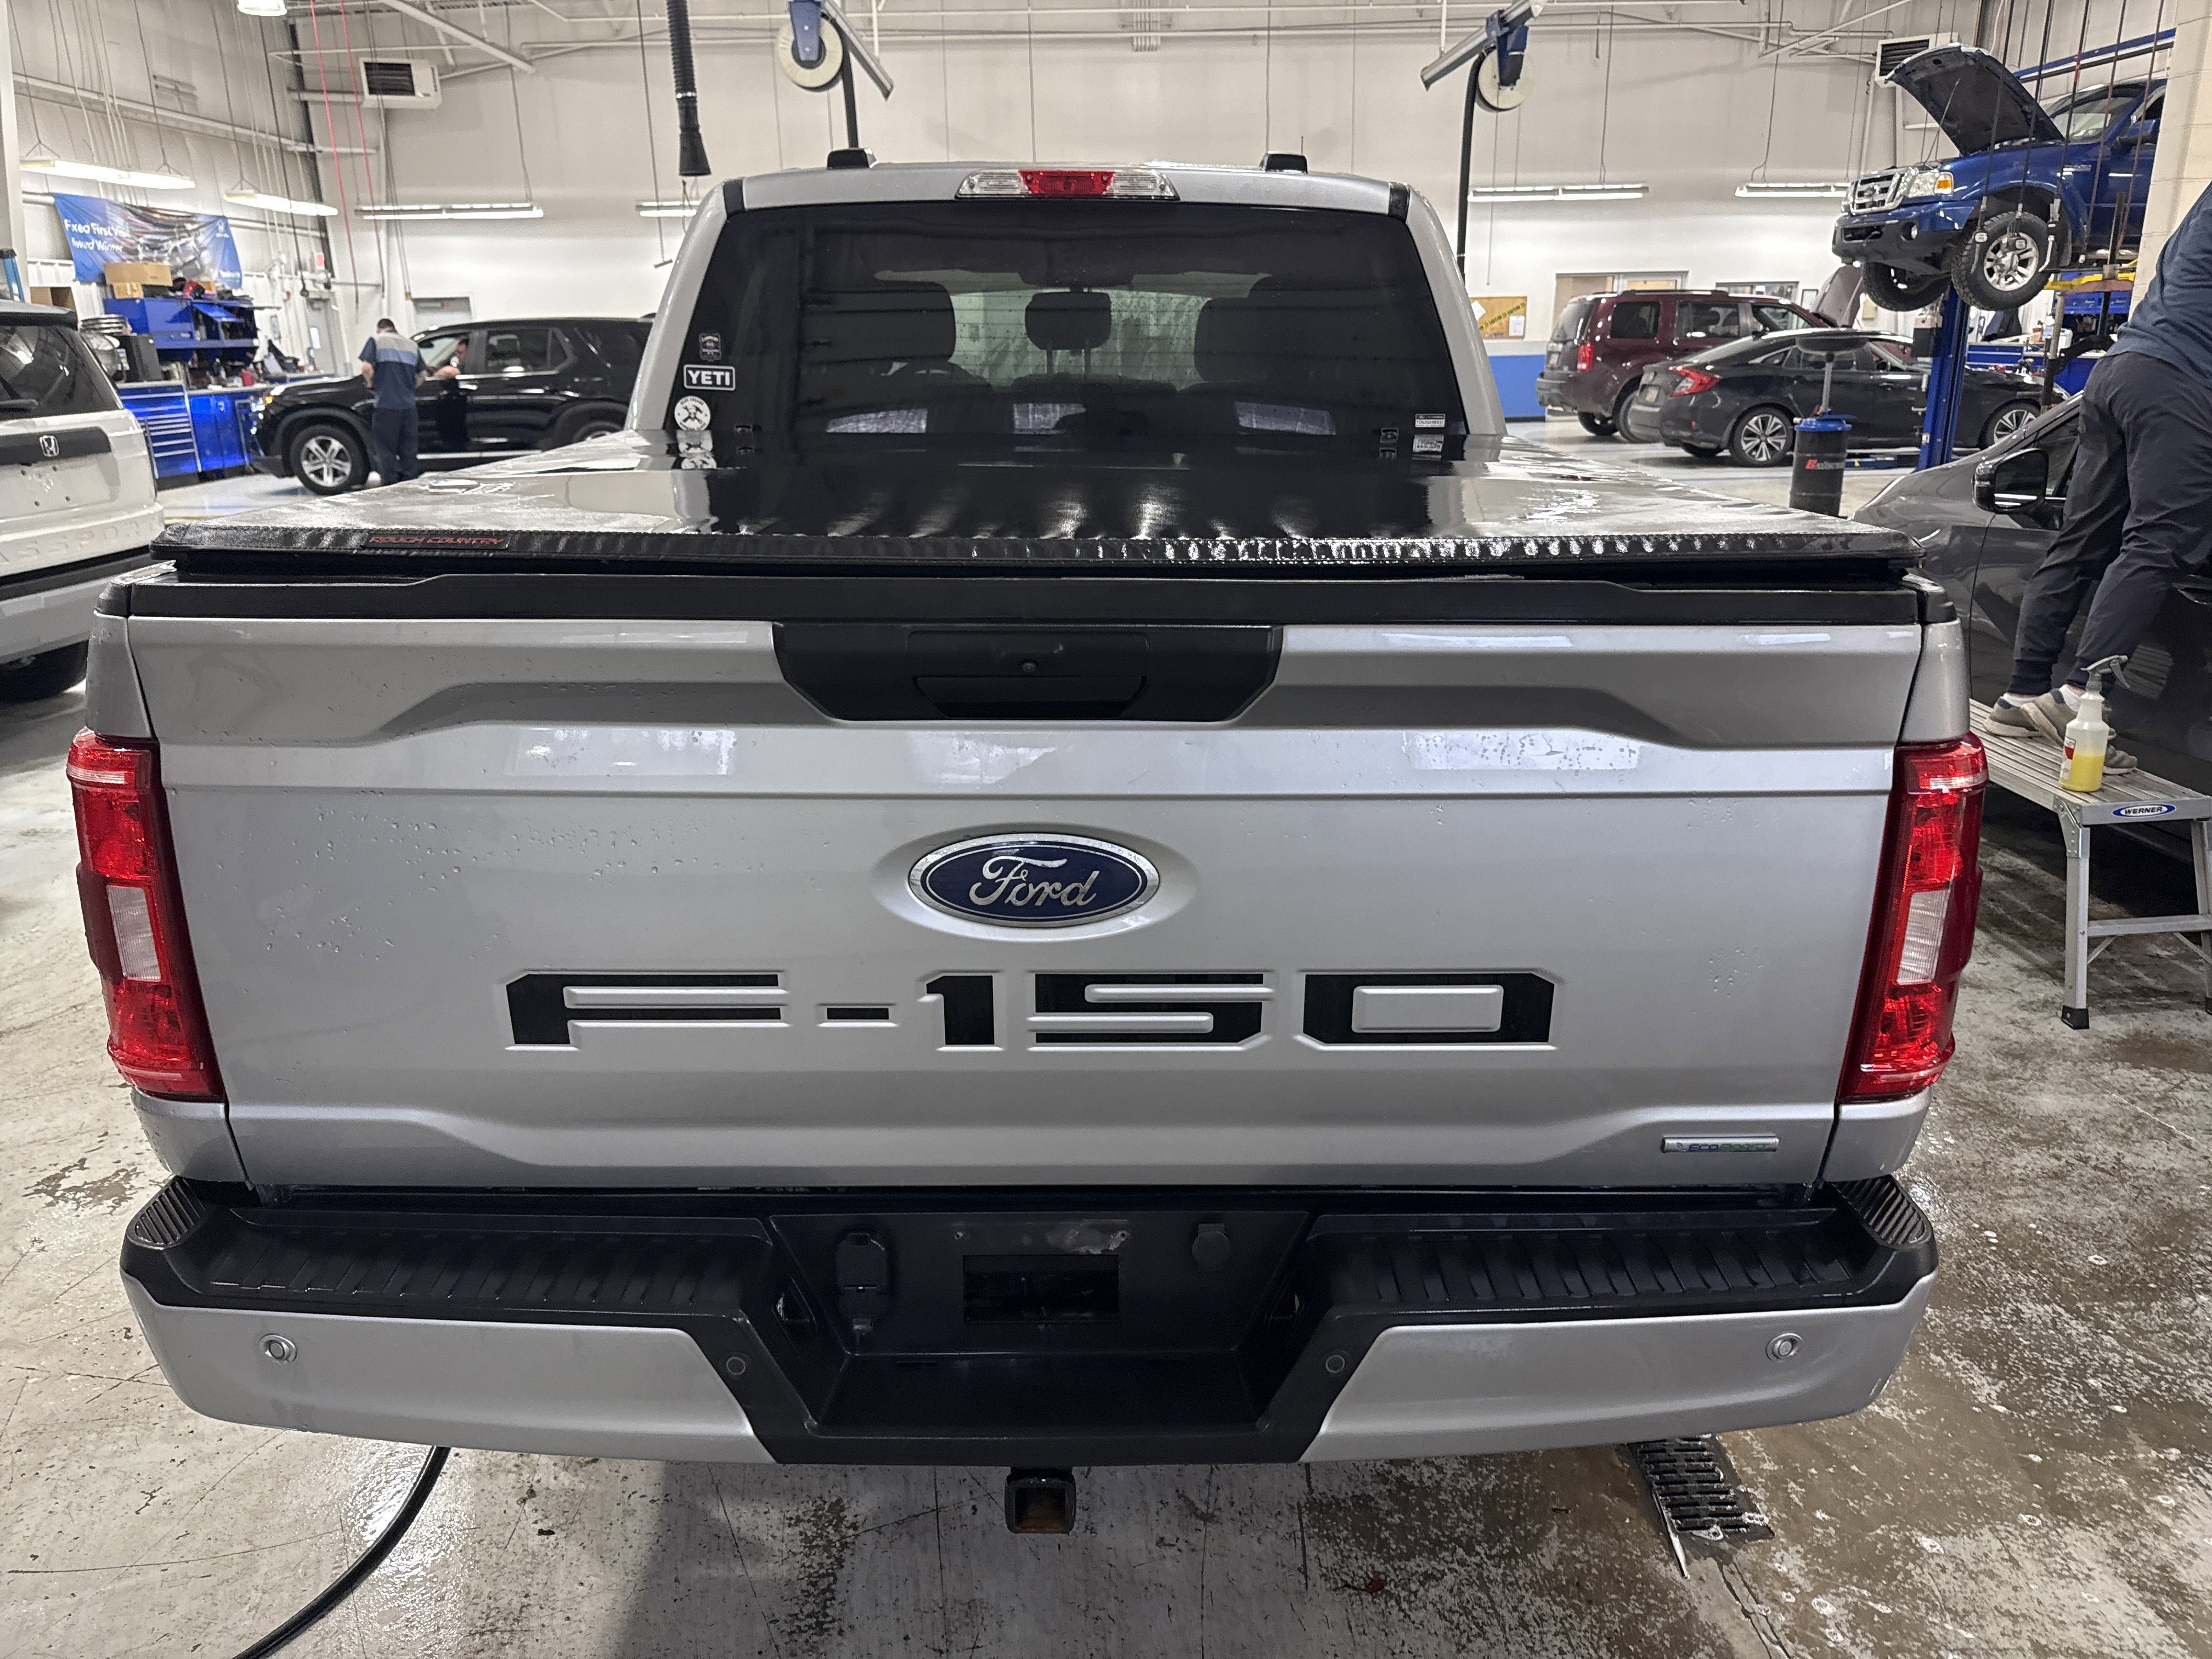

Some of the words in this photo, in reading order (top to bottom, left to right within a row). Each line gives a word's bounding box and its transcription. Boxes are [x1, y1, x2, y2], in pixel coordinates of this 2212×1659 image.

[687, 370, 730, 386] YETI
[2125, 806, 2163, 815] WERNER
[969, 855, 1100, 907] Ford
[505, 972, 1555, 1046] F-150
